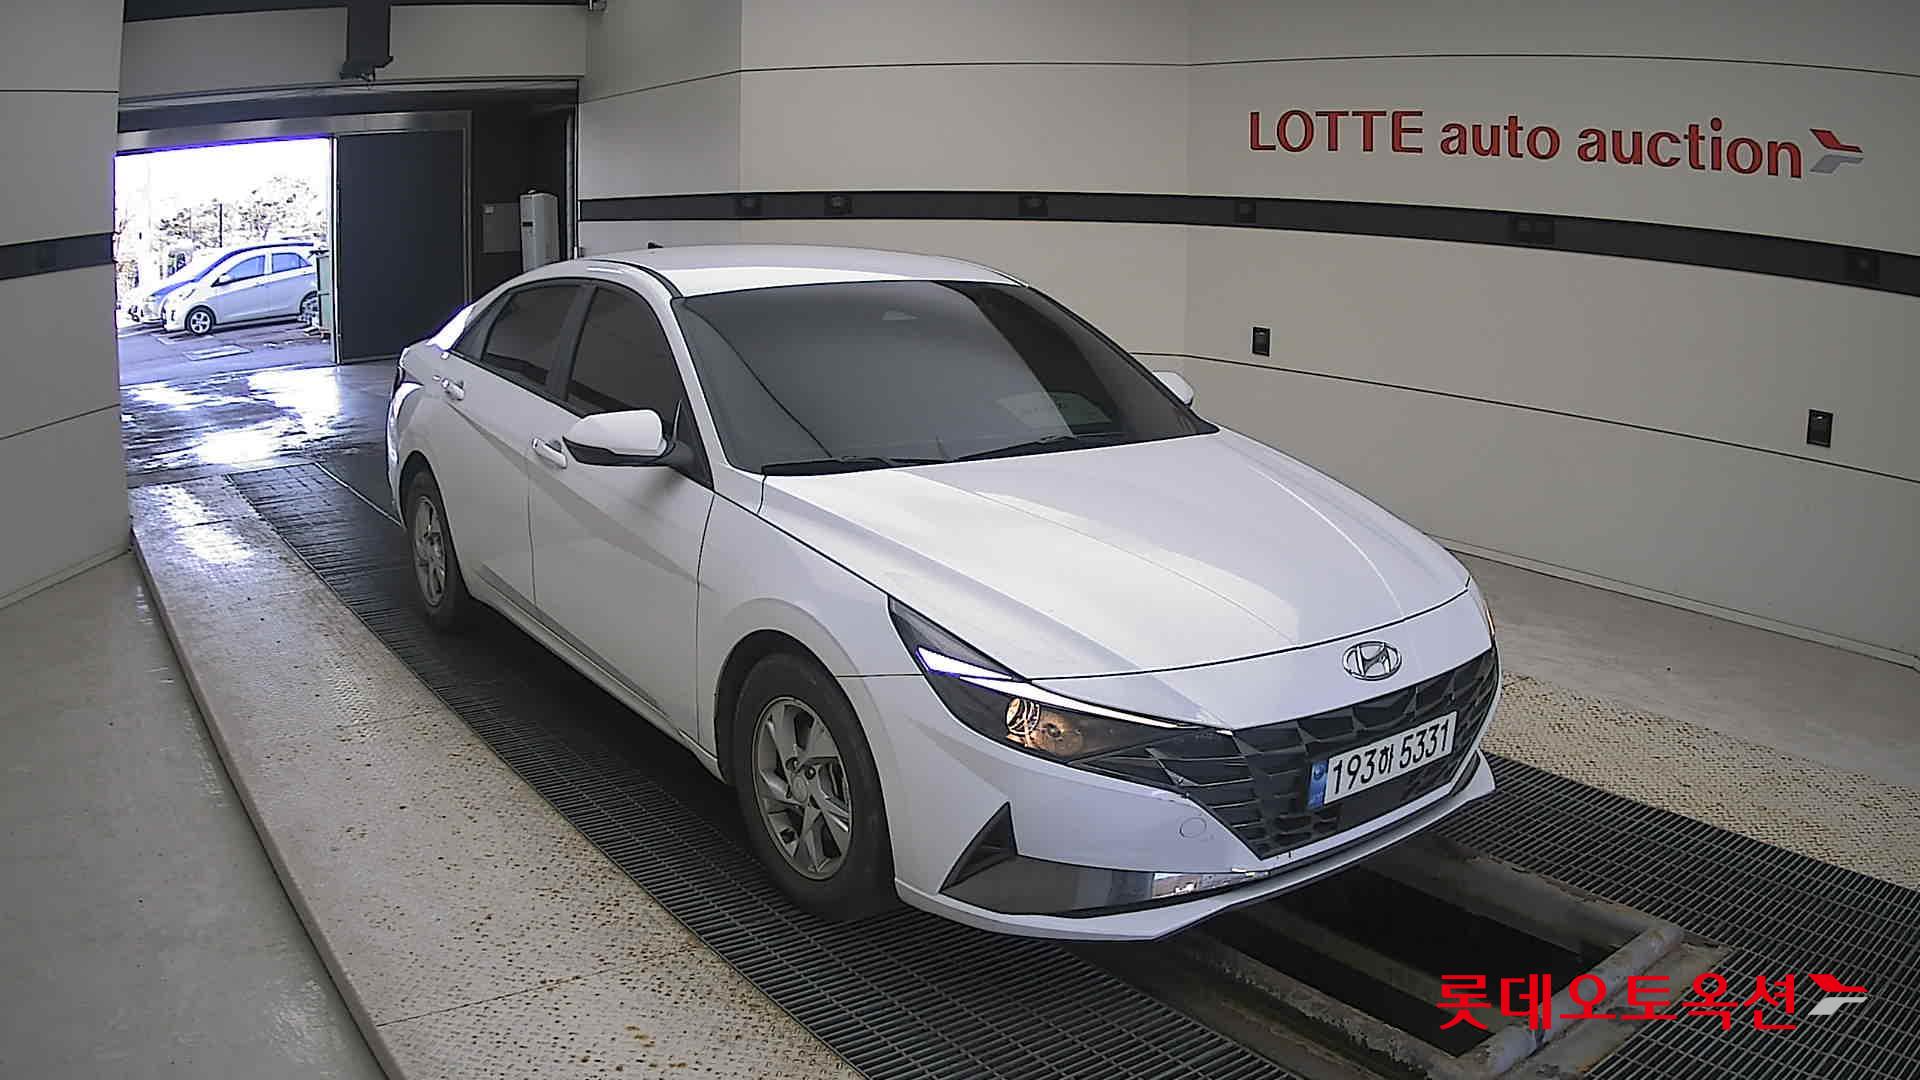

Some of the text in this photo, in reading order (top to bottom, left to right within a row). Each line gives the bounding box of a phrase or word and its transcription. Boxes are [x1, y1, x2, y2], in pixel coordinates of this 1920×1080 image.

[1249, 110, 1803, 179] LOTTE auto auction
[1332, 718, 1450, 795] 193하 5331
